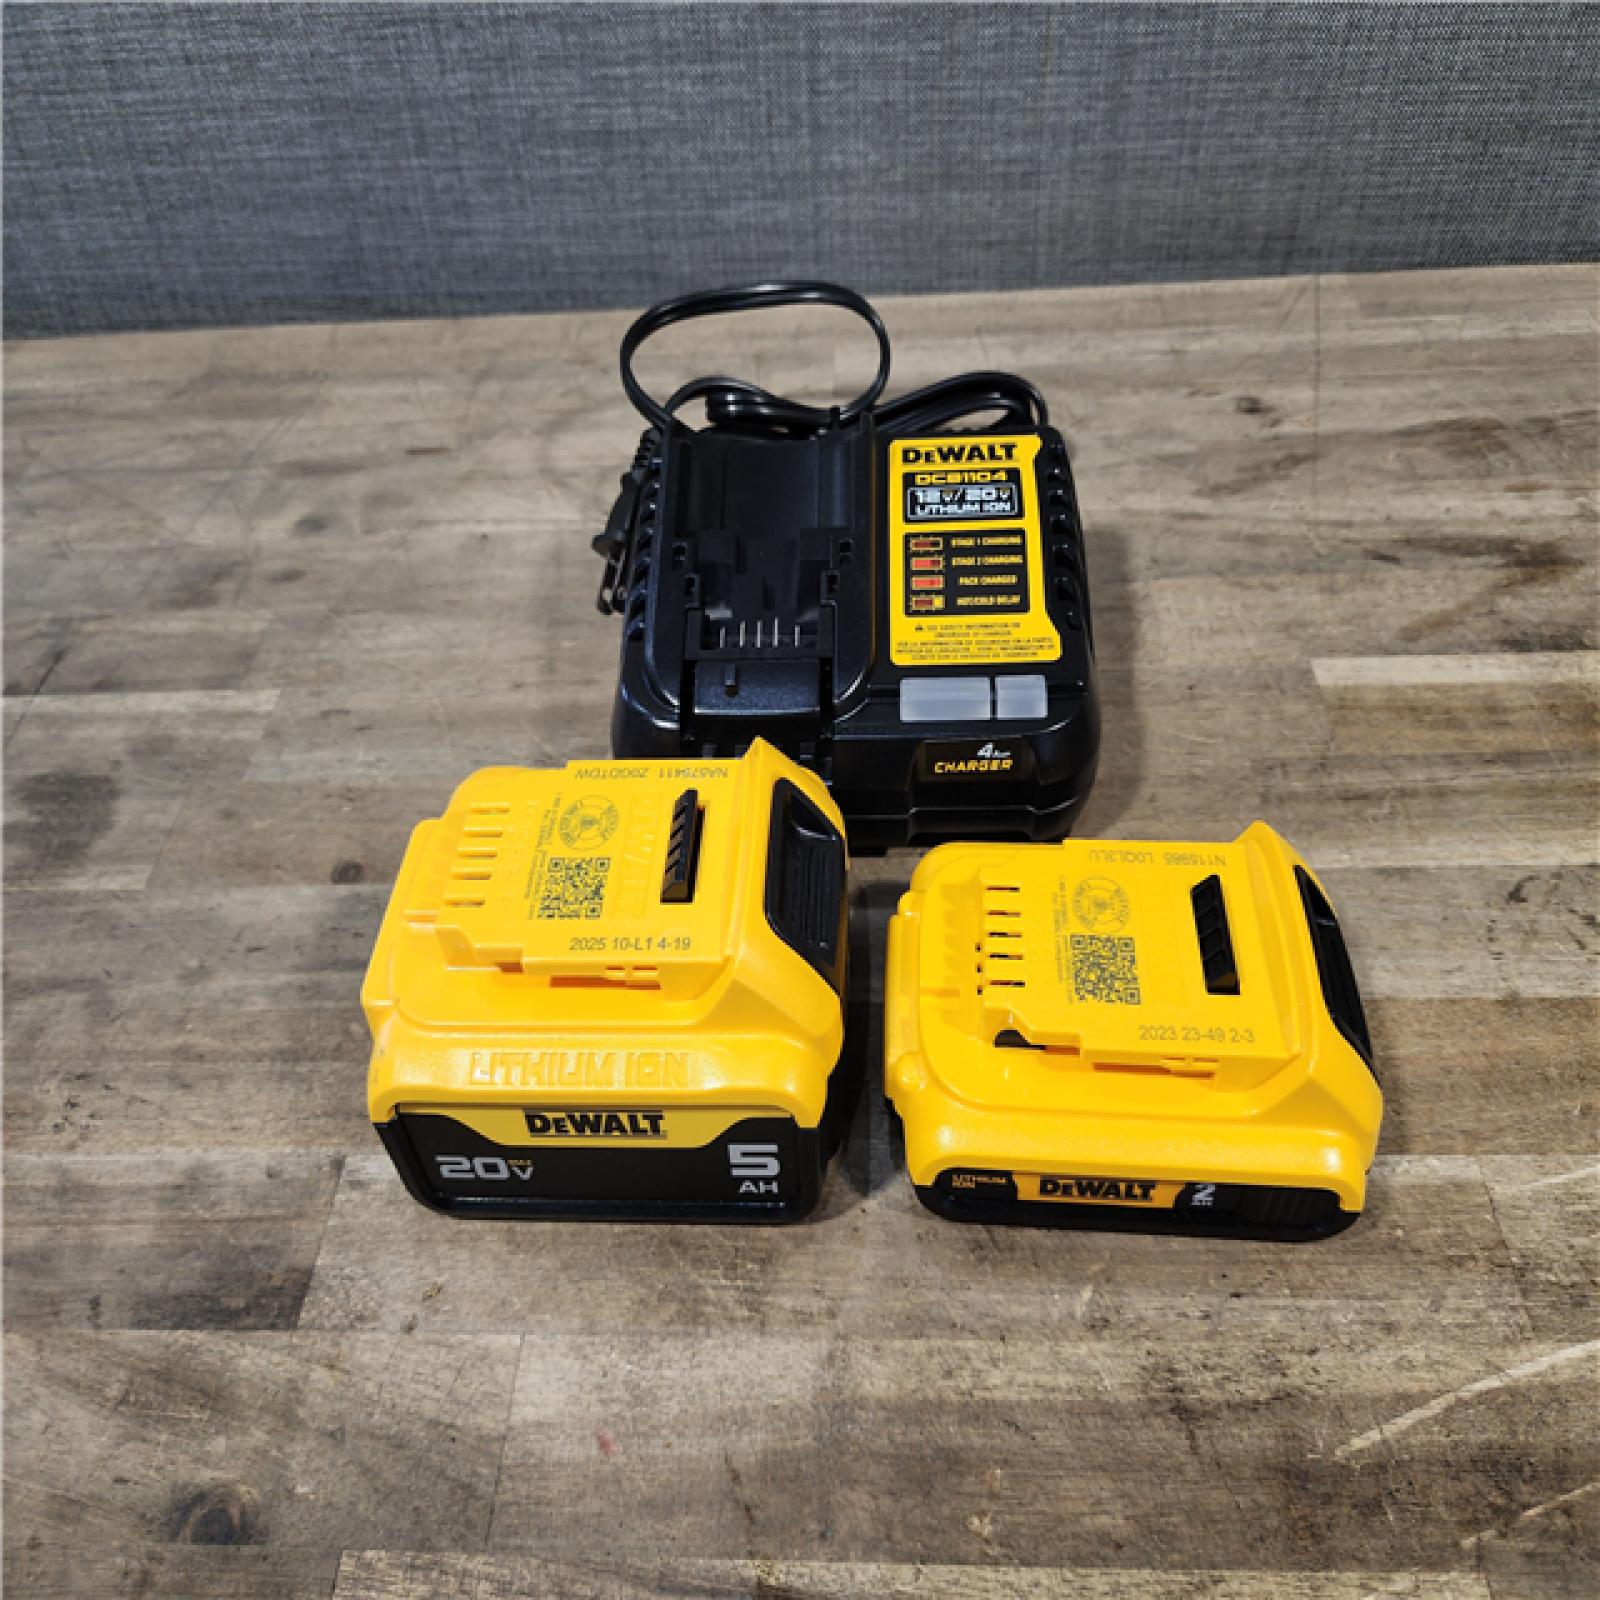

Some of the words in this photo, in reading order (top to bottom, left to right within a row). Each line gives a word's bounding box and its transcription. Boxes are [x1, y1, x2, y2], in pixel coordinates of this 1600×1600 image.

[916, 503, 981, 515] LITHIUM
[983, 501, 1011, 513] ION
[934, 759, 1014, 773] CHARGER
[569, 937, 606, 951] 2025
[1139, 1024, 1177, 1040] 2023
[469, 1052, 616, 1087] LITHIUM
[624, 1052, 689, 1087] ION
[727, 1143, 780, 1177] 5
[739, 1180, 779, 1194] AH
